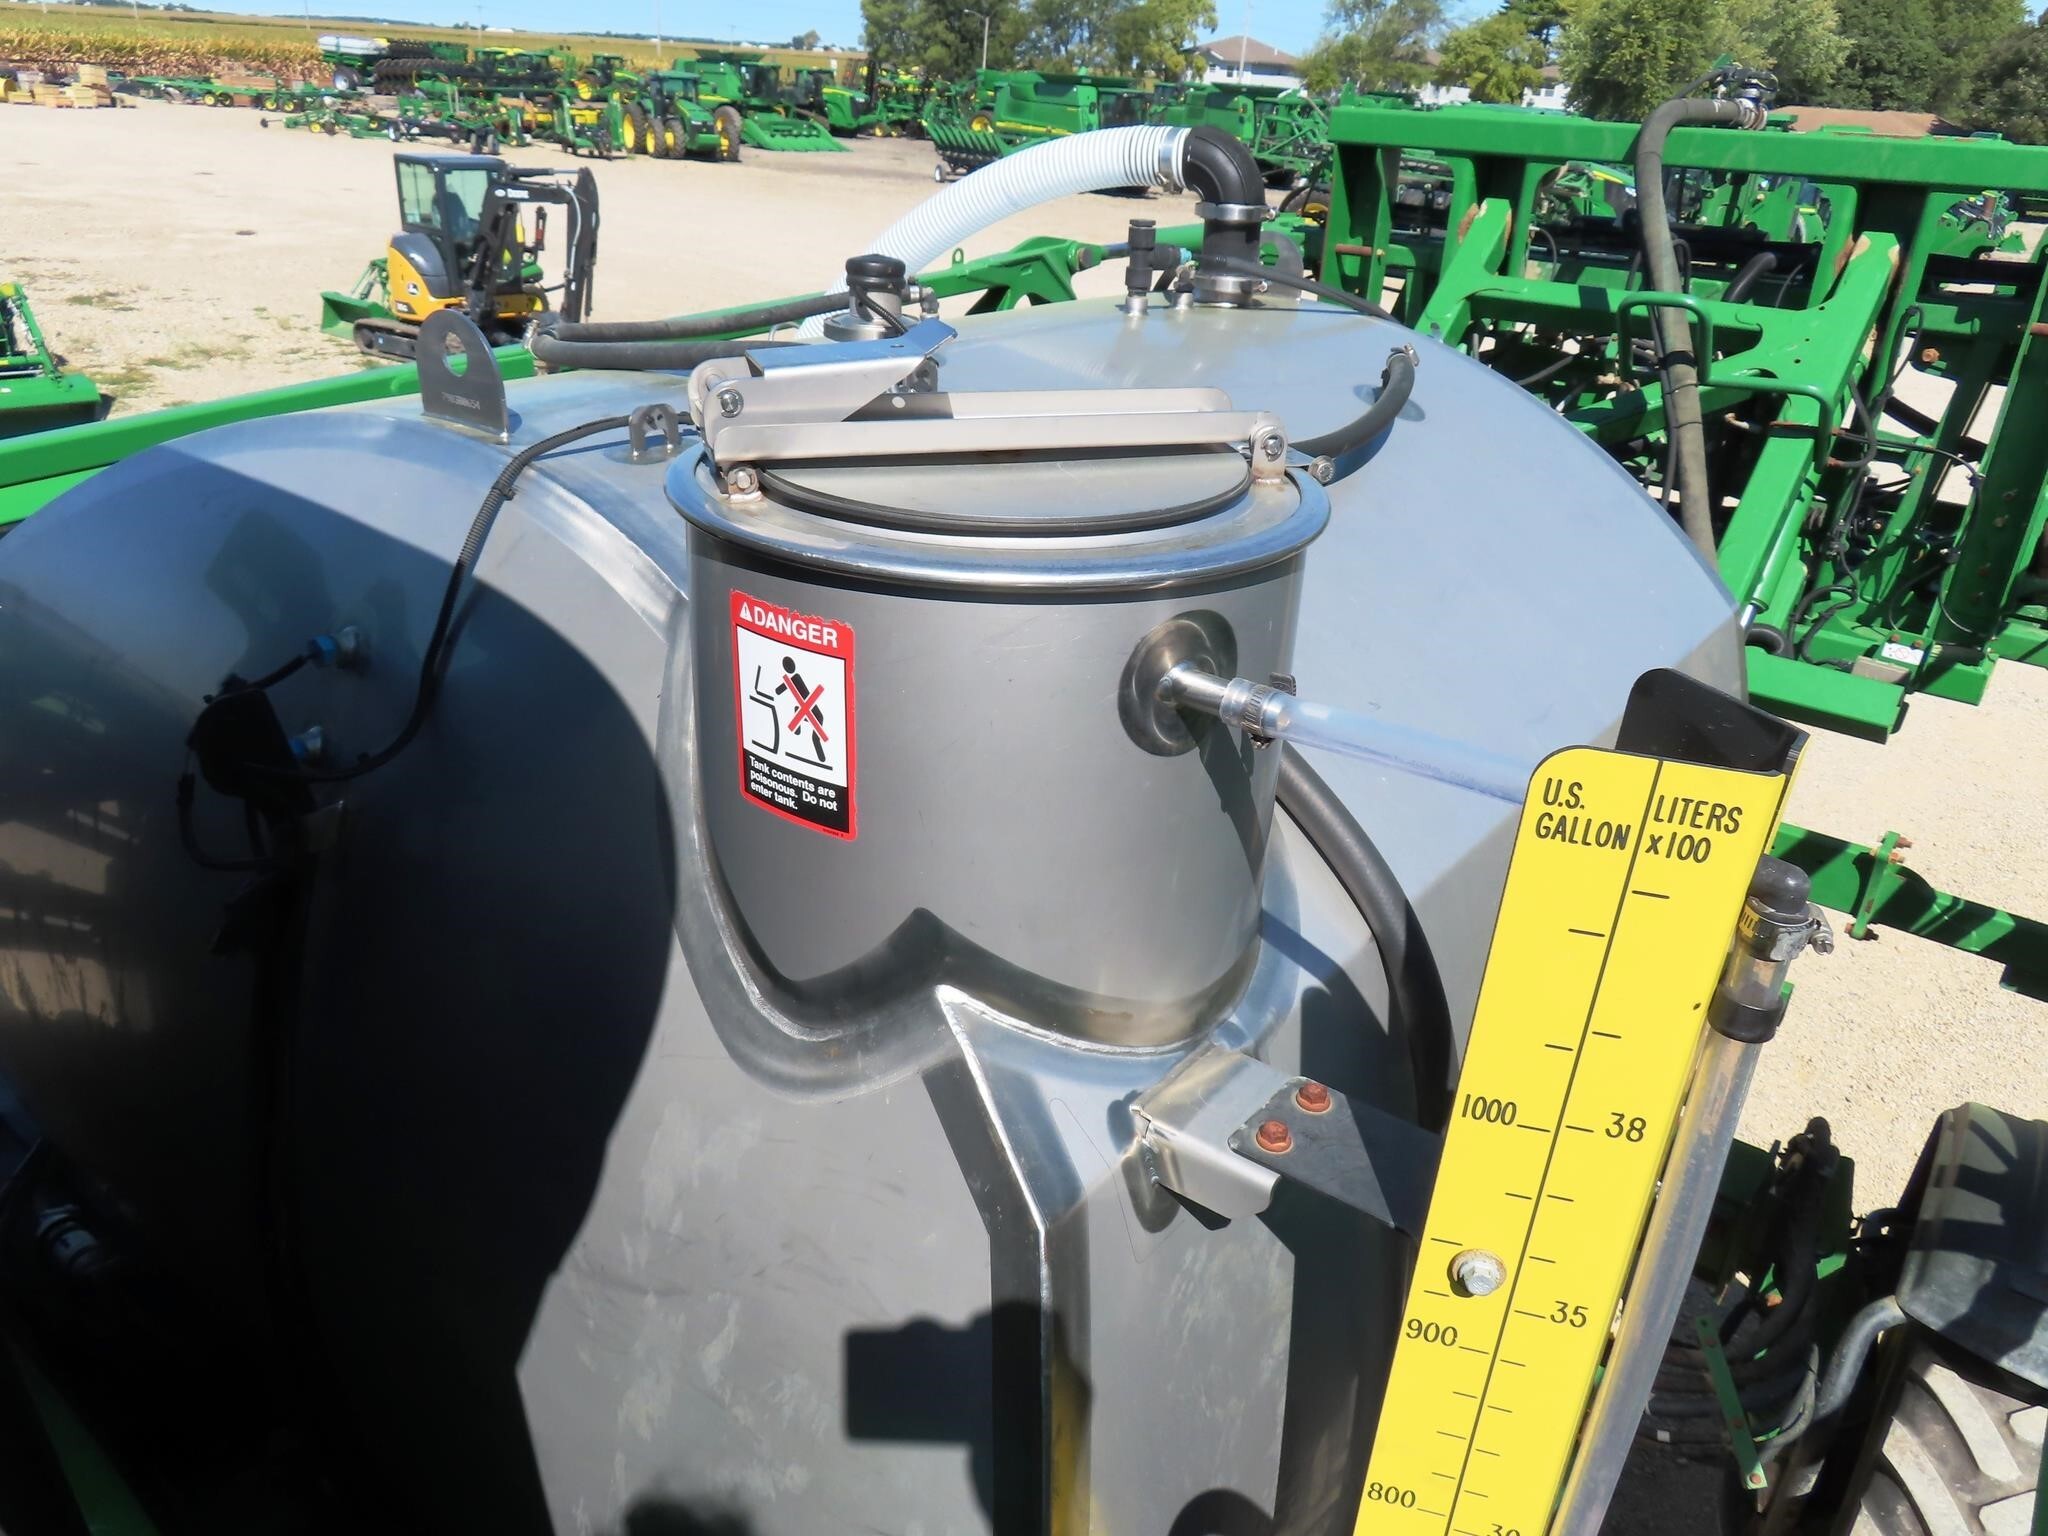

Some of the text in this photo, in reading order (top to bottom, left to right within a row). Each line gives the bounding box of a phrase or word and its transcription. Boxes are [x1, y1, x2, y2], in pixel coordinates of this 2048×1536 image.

[753, 606, 838, 649] DANGER
[749, 755, 836, 798] Tank contents are
[750, 769, 838, 811] poisonous. Do not
[750, 781, 798, 810] enter tank.
[1542, 777, 1585, 810] U.S.
[1653, 794, 1743, 834] LITERS
[1535, 812, 1631, 850] GALLON
[1460, 1093, 1517, 1127] 1000
[1604, 1112, 1647, 1143] 38
[1549, 1300, 1588, 1329] 35
[1405, 1318, 1458, 1347] 900
[1367, 1481, 1417, 1509] 800
